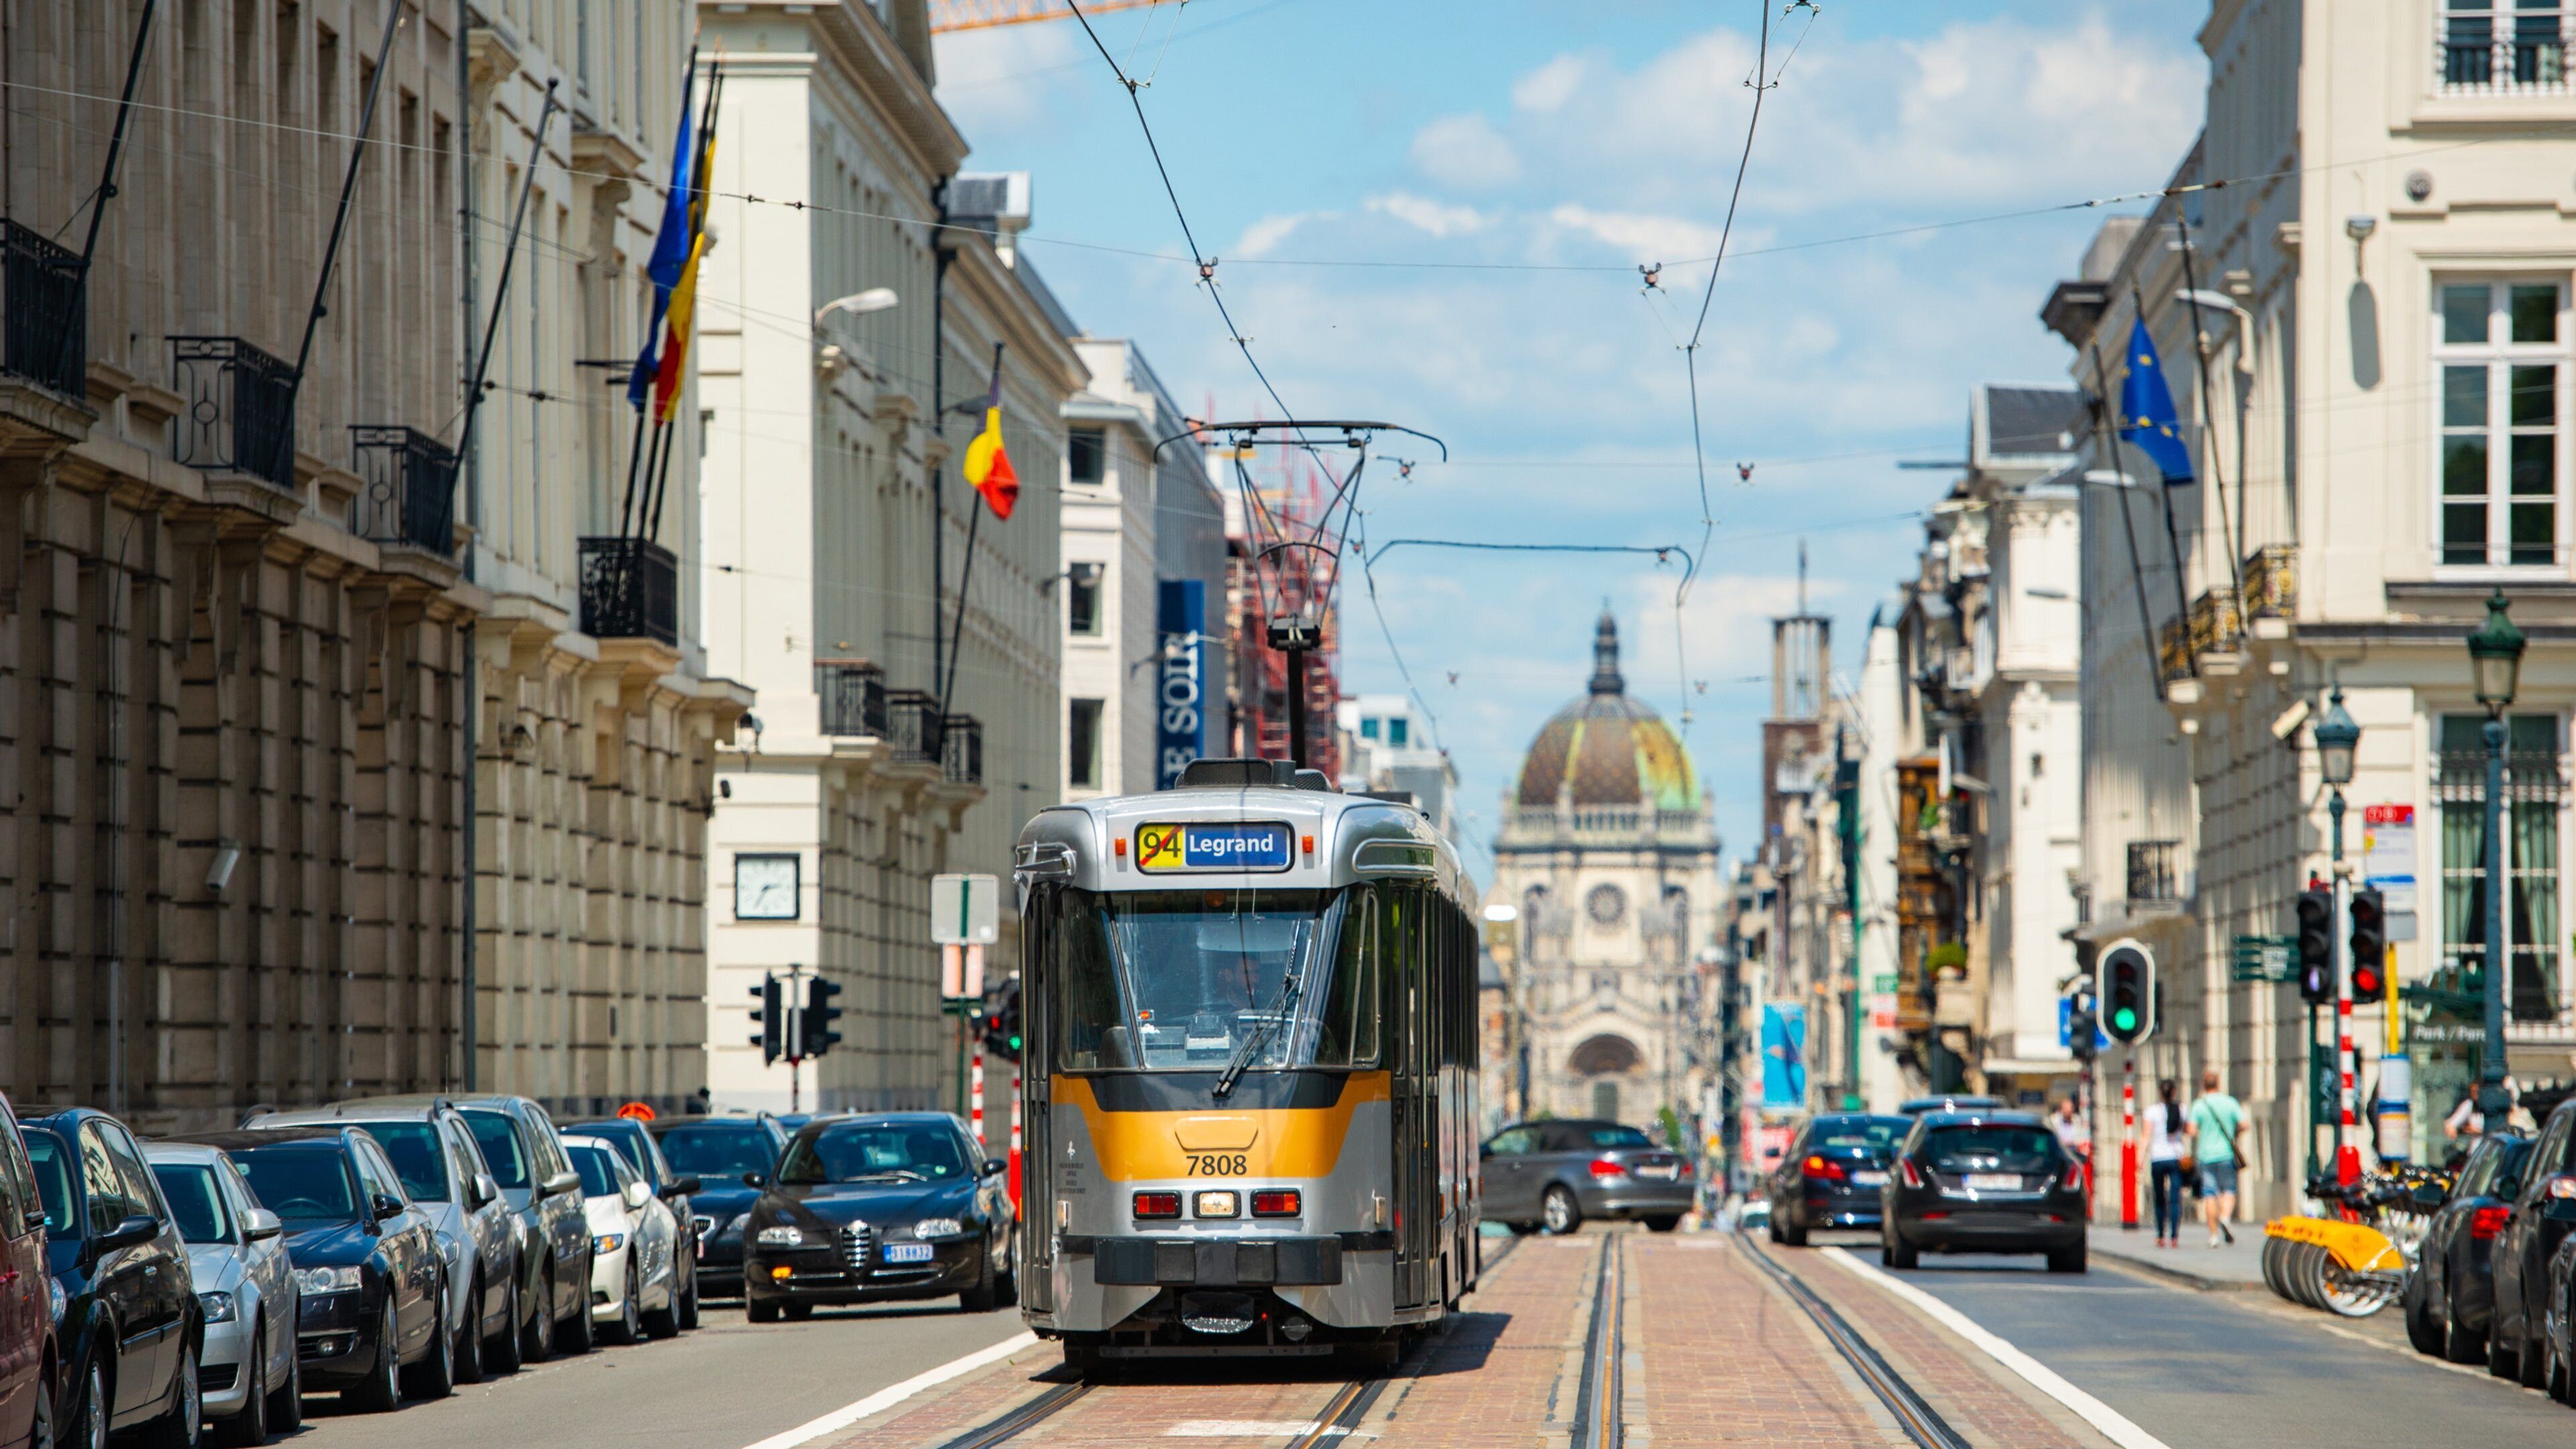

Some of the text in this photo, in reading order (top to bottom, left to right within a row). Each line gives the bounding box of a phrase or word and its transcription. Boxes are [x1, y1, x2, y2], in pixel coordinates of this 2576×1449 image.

[1163, 629, 1198, 733] SOIR
[1143, 832, 1273, 858] 94 Legrand
[2414, 1025, 2445, 1040] Park
[1186, 1155, 1247, 1176] 7808
